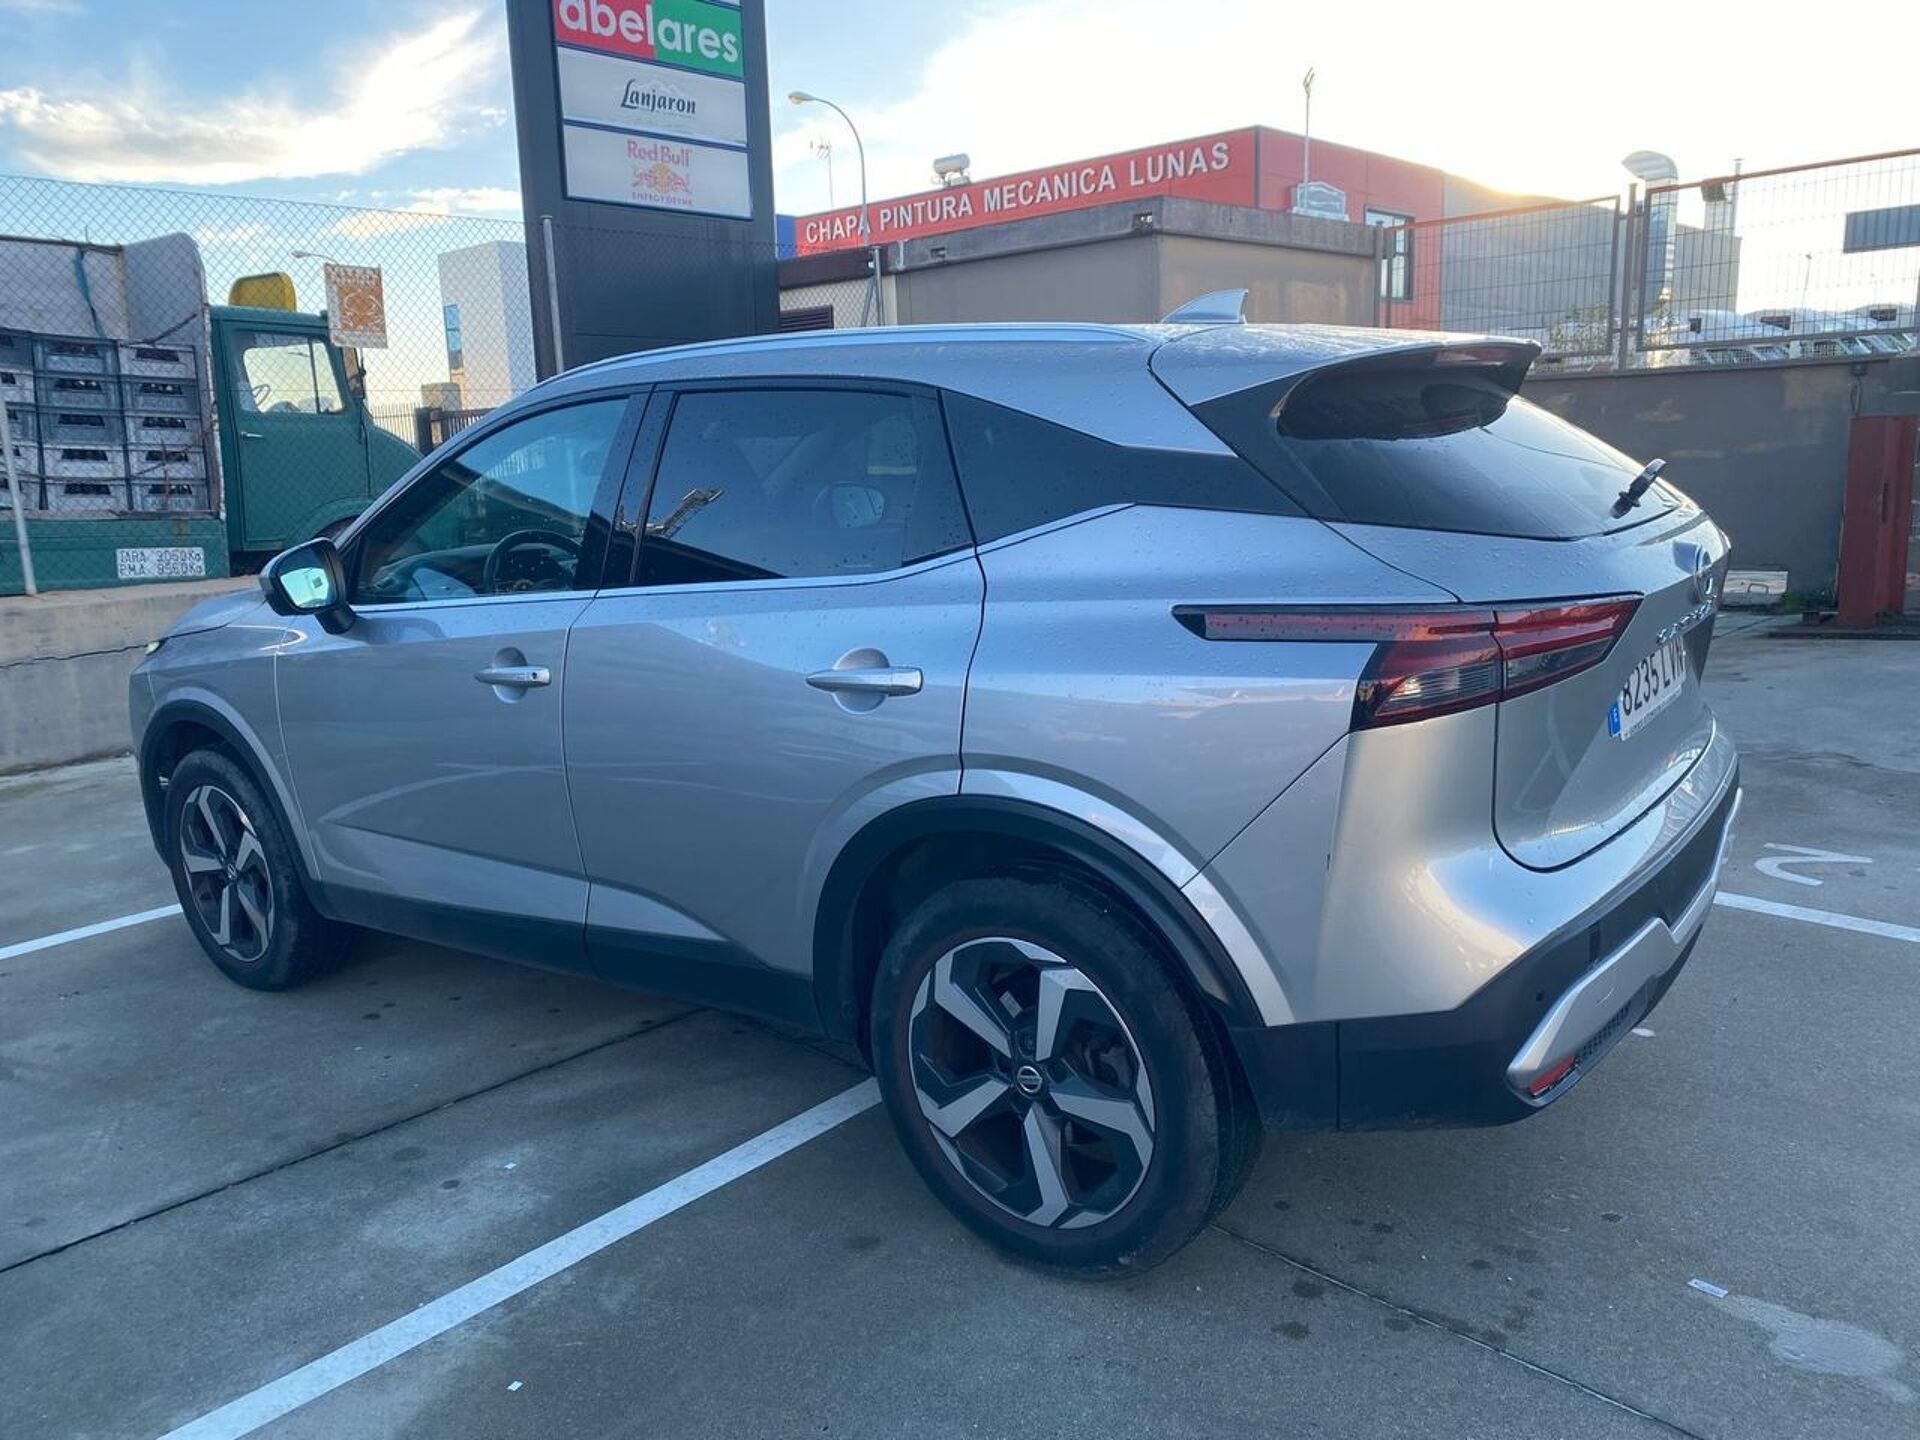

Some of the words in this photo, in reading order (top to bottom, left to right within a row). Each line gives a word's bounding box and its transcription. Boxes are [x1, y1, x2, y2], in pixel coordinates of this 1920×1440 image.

[559, 0, 739, 63] abelares
[627, 140, 658, 162] Red
[660, 144, 691, 168] Bull
[805, 210, 871, 245] CHAPA
[880, 189, 973, 231] PINTURA
[983, 164, 1116, 212] MECANICA
[1128, 141, 1231, 187] LUNAS
[1622, 652, 1659, 716] 8235
